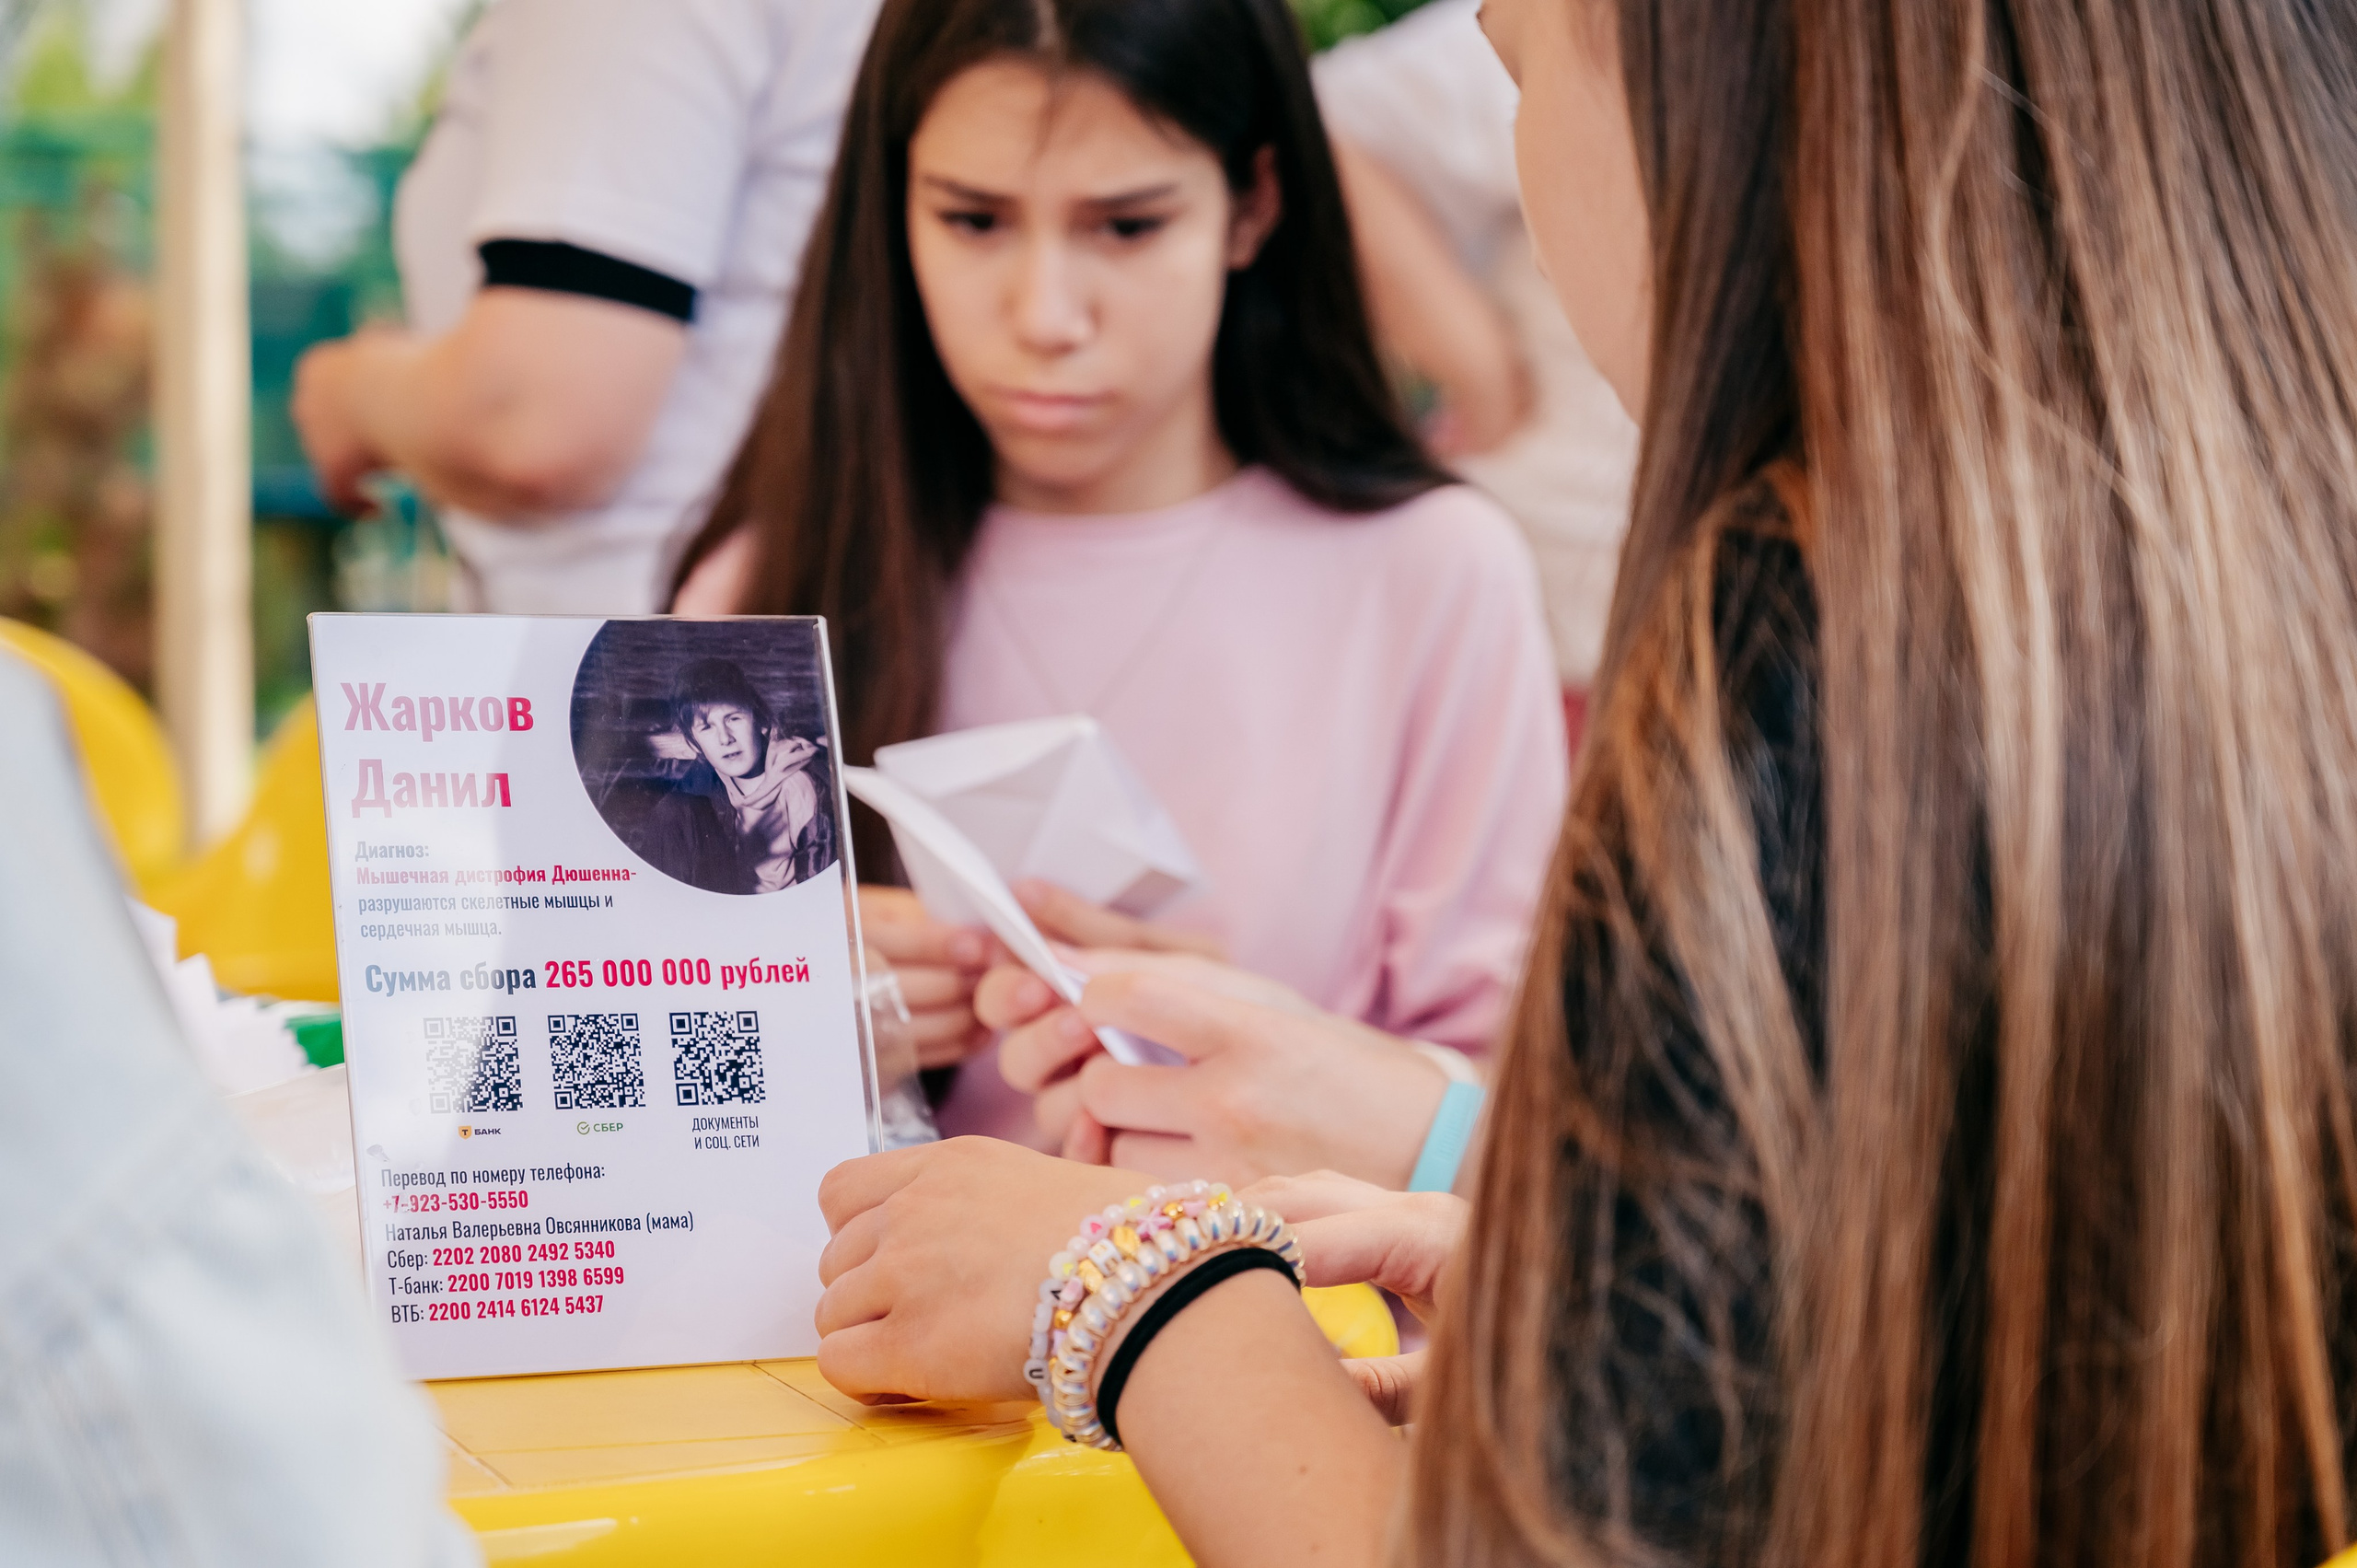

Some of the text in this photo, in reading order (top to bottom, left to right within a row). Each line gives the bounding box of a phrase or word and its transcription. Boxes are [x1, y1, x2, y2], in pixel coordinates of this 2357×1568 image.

[341, 681, 534, 742] Жарков
[351, 759, 512, 819] Данил
[354, 841, 429, 862] Диагноз:
[356, 865, 637, 887] Мышечная дистрофия Дюшенна-
[358, 894, 613, 914] разрушаются скелетные мышцы и
[360, 922, 502, 941] сердечная мышца.
[366, 956, 810, 997] Сумма сбора 265 000 000 рублей
[473, 1128, 502, 1136] БАНК
[593, 1122, 624, 1132] СБЕР
[691, 1115, 760, 1132] ДОКУМЕНТЫ
[694, 1134, 761, 1151] И СОЦ. СЕТИ
[381, 1162, 606, 1190] Перевод по номеру телефона:
[383, 1190, 528, 1213] +7-923-530-5550
[385, 1211, 694, 1241] Наталья Валерьевна Овсянникова (мама)
[388, 1240, 616, 1271] Сбер: 2202 2080 2492 5340
[389, 1267, 624, 1295] Т-банк: 2200 7019 1398 6599
[391, 1295, 604, 1325] ВТБ: 2200 2414 6124 5437
